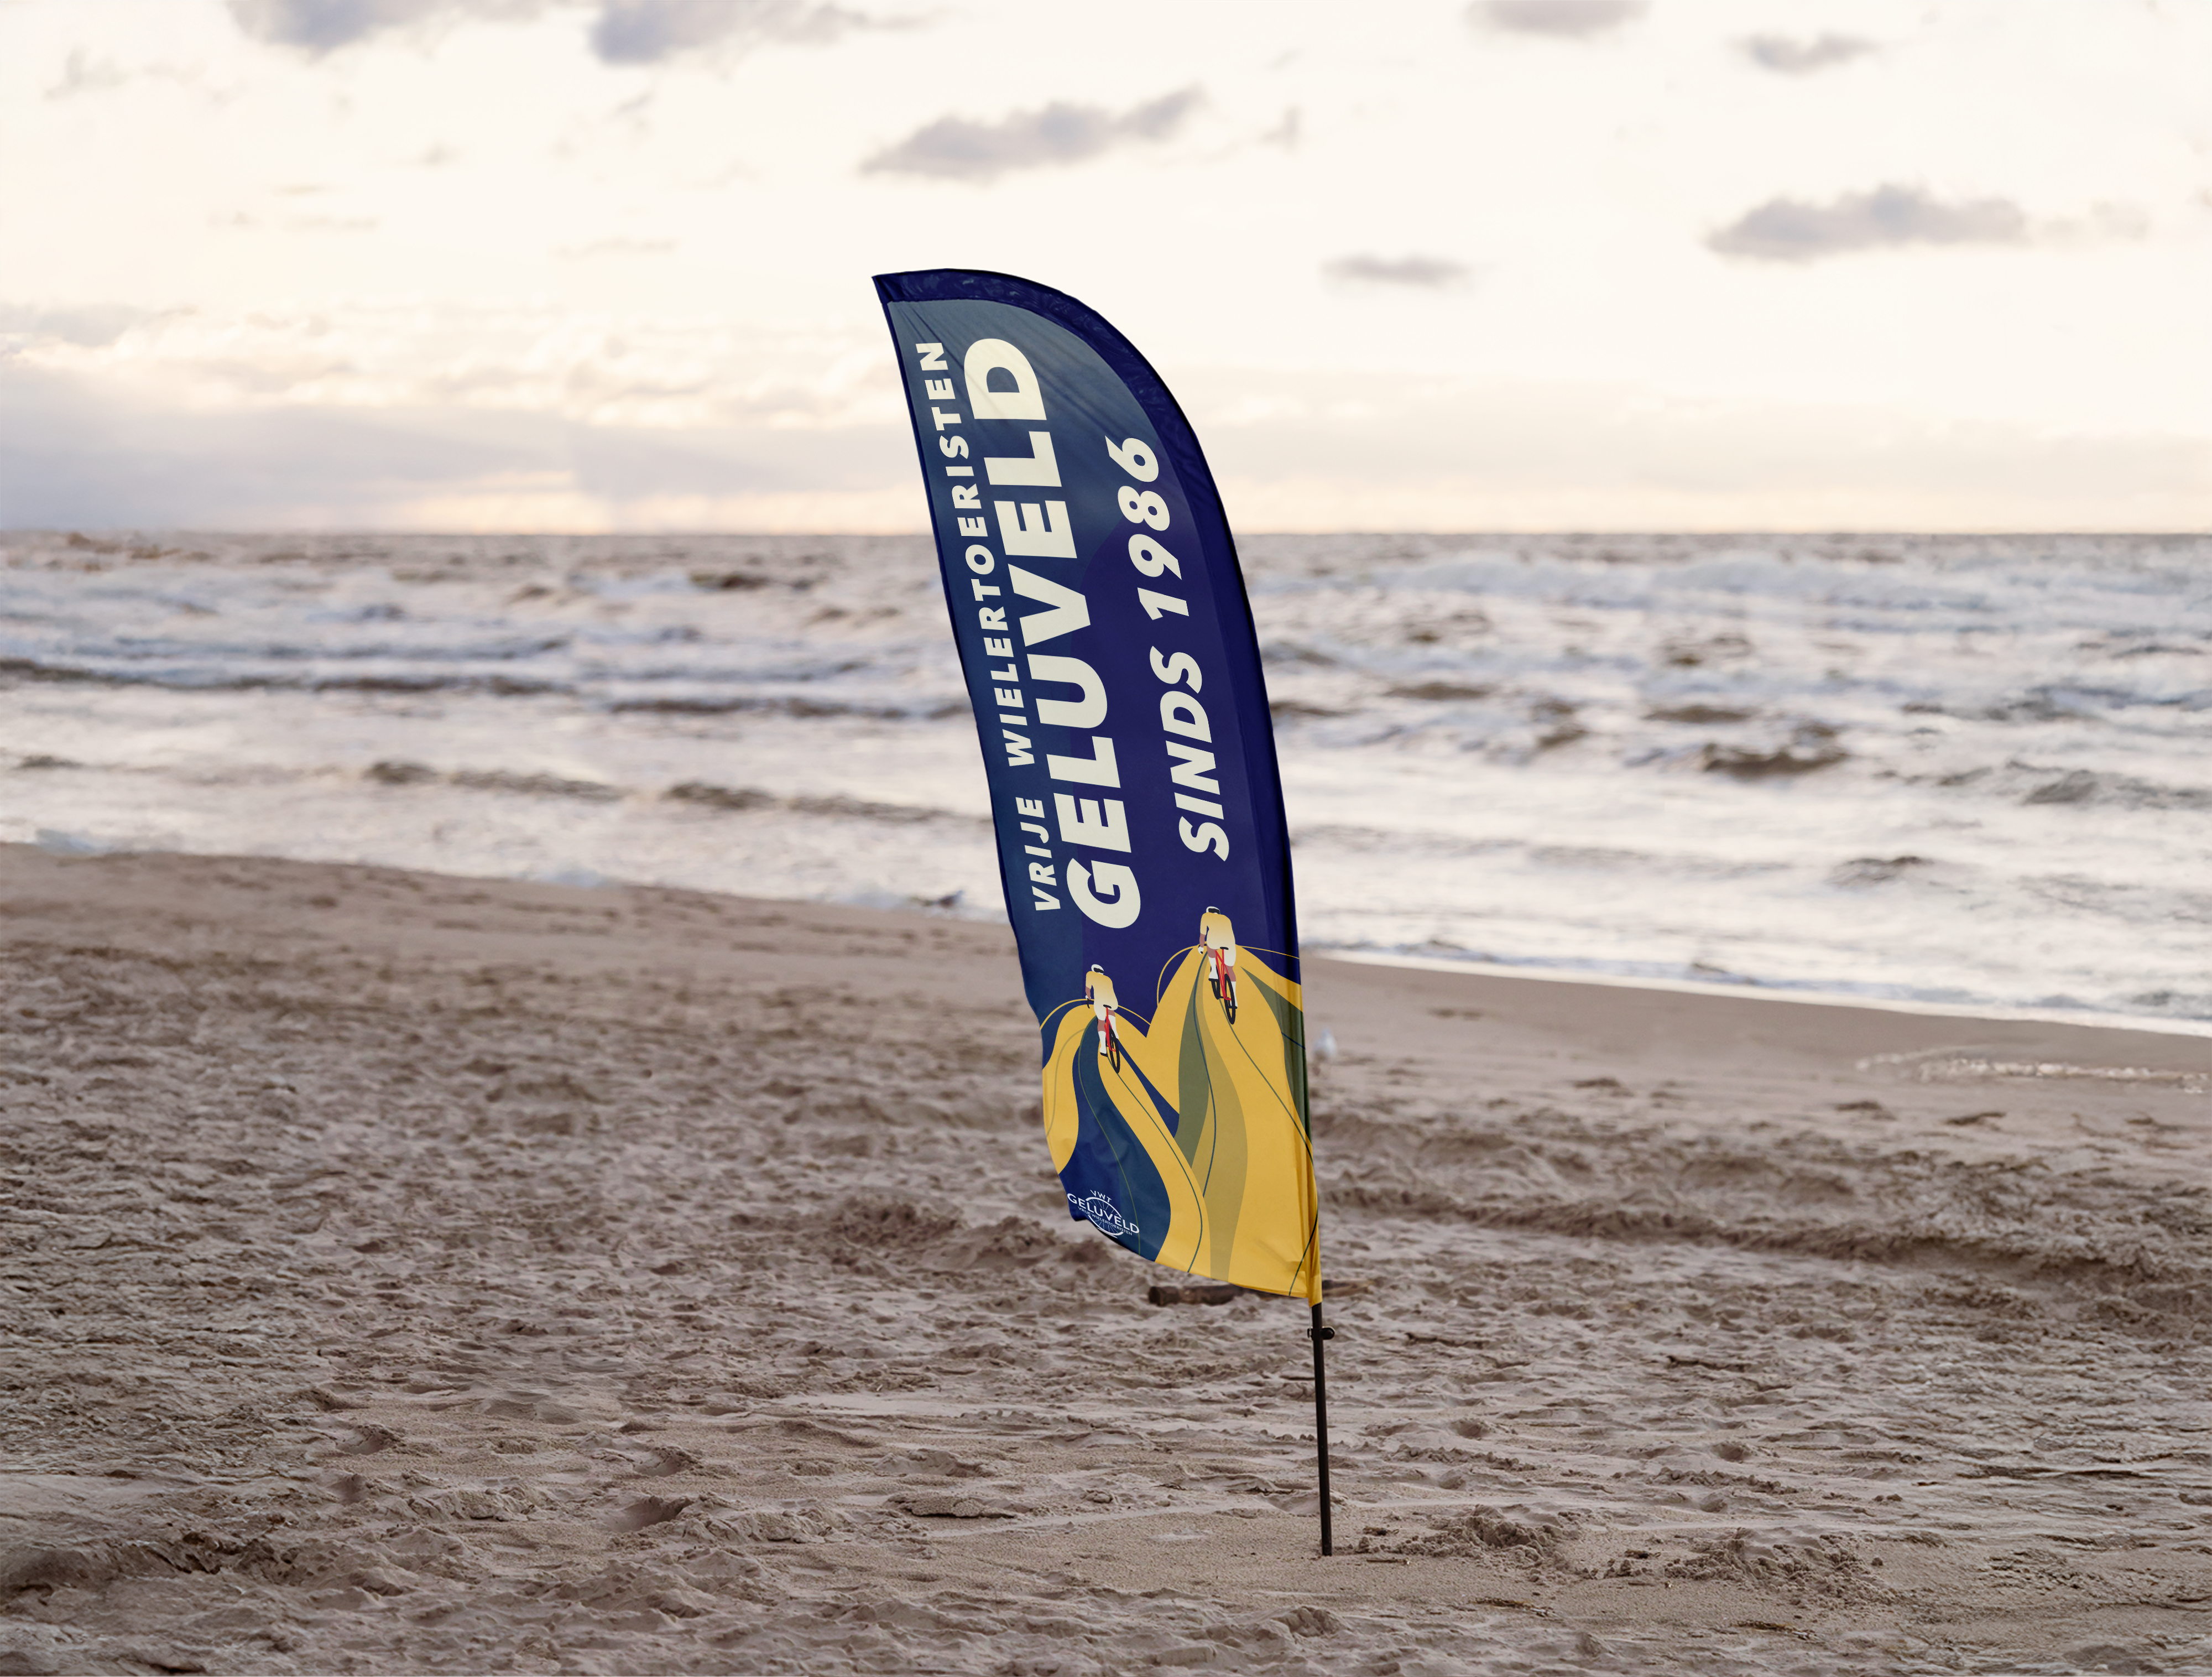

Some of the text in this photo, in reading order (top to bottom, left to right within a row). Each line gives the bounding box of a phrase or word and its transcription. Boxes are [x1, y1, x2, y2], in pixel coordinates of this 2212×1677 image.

[916, 343, 1061, 911] VRIJE WIELERTOERISTEN
[964, 338, 1141, 929] GELUVELD
[1105, 435, 1229, 862] SINDS 1986
[1067, 1193, 1140, 1233] GELUVELD
[1078, 1206, 1133, 1236] VRIJE WIELERTOERISTEN
[1090, 1189, 1112, 1202] VWT
